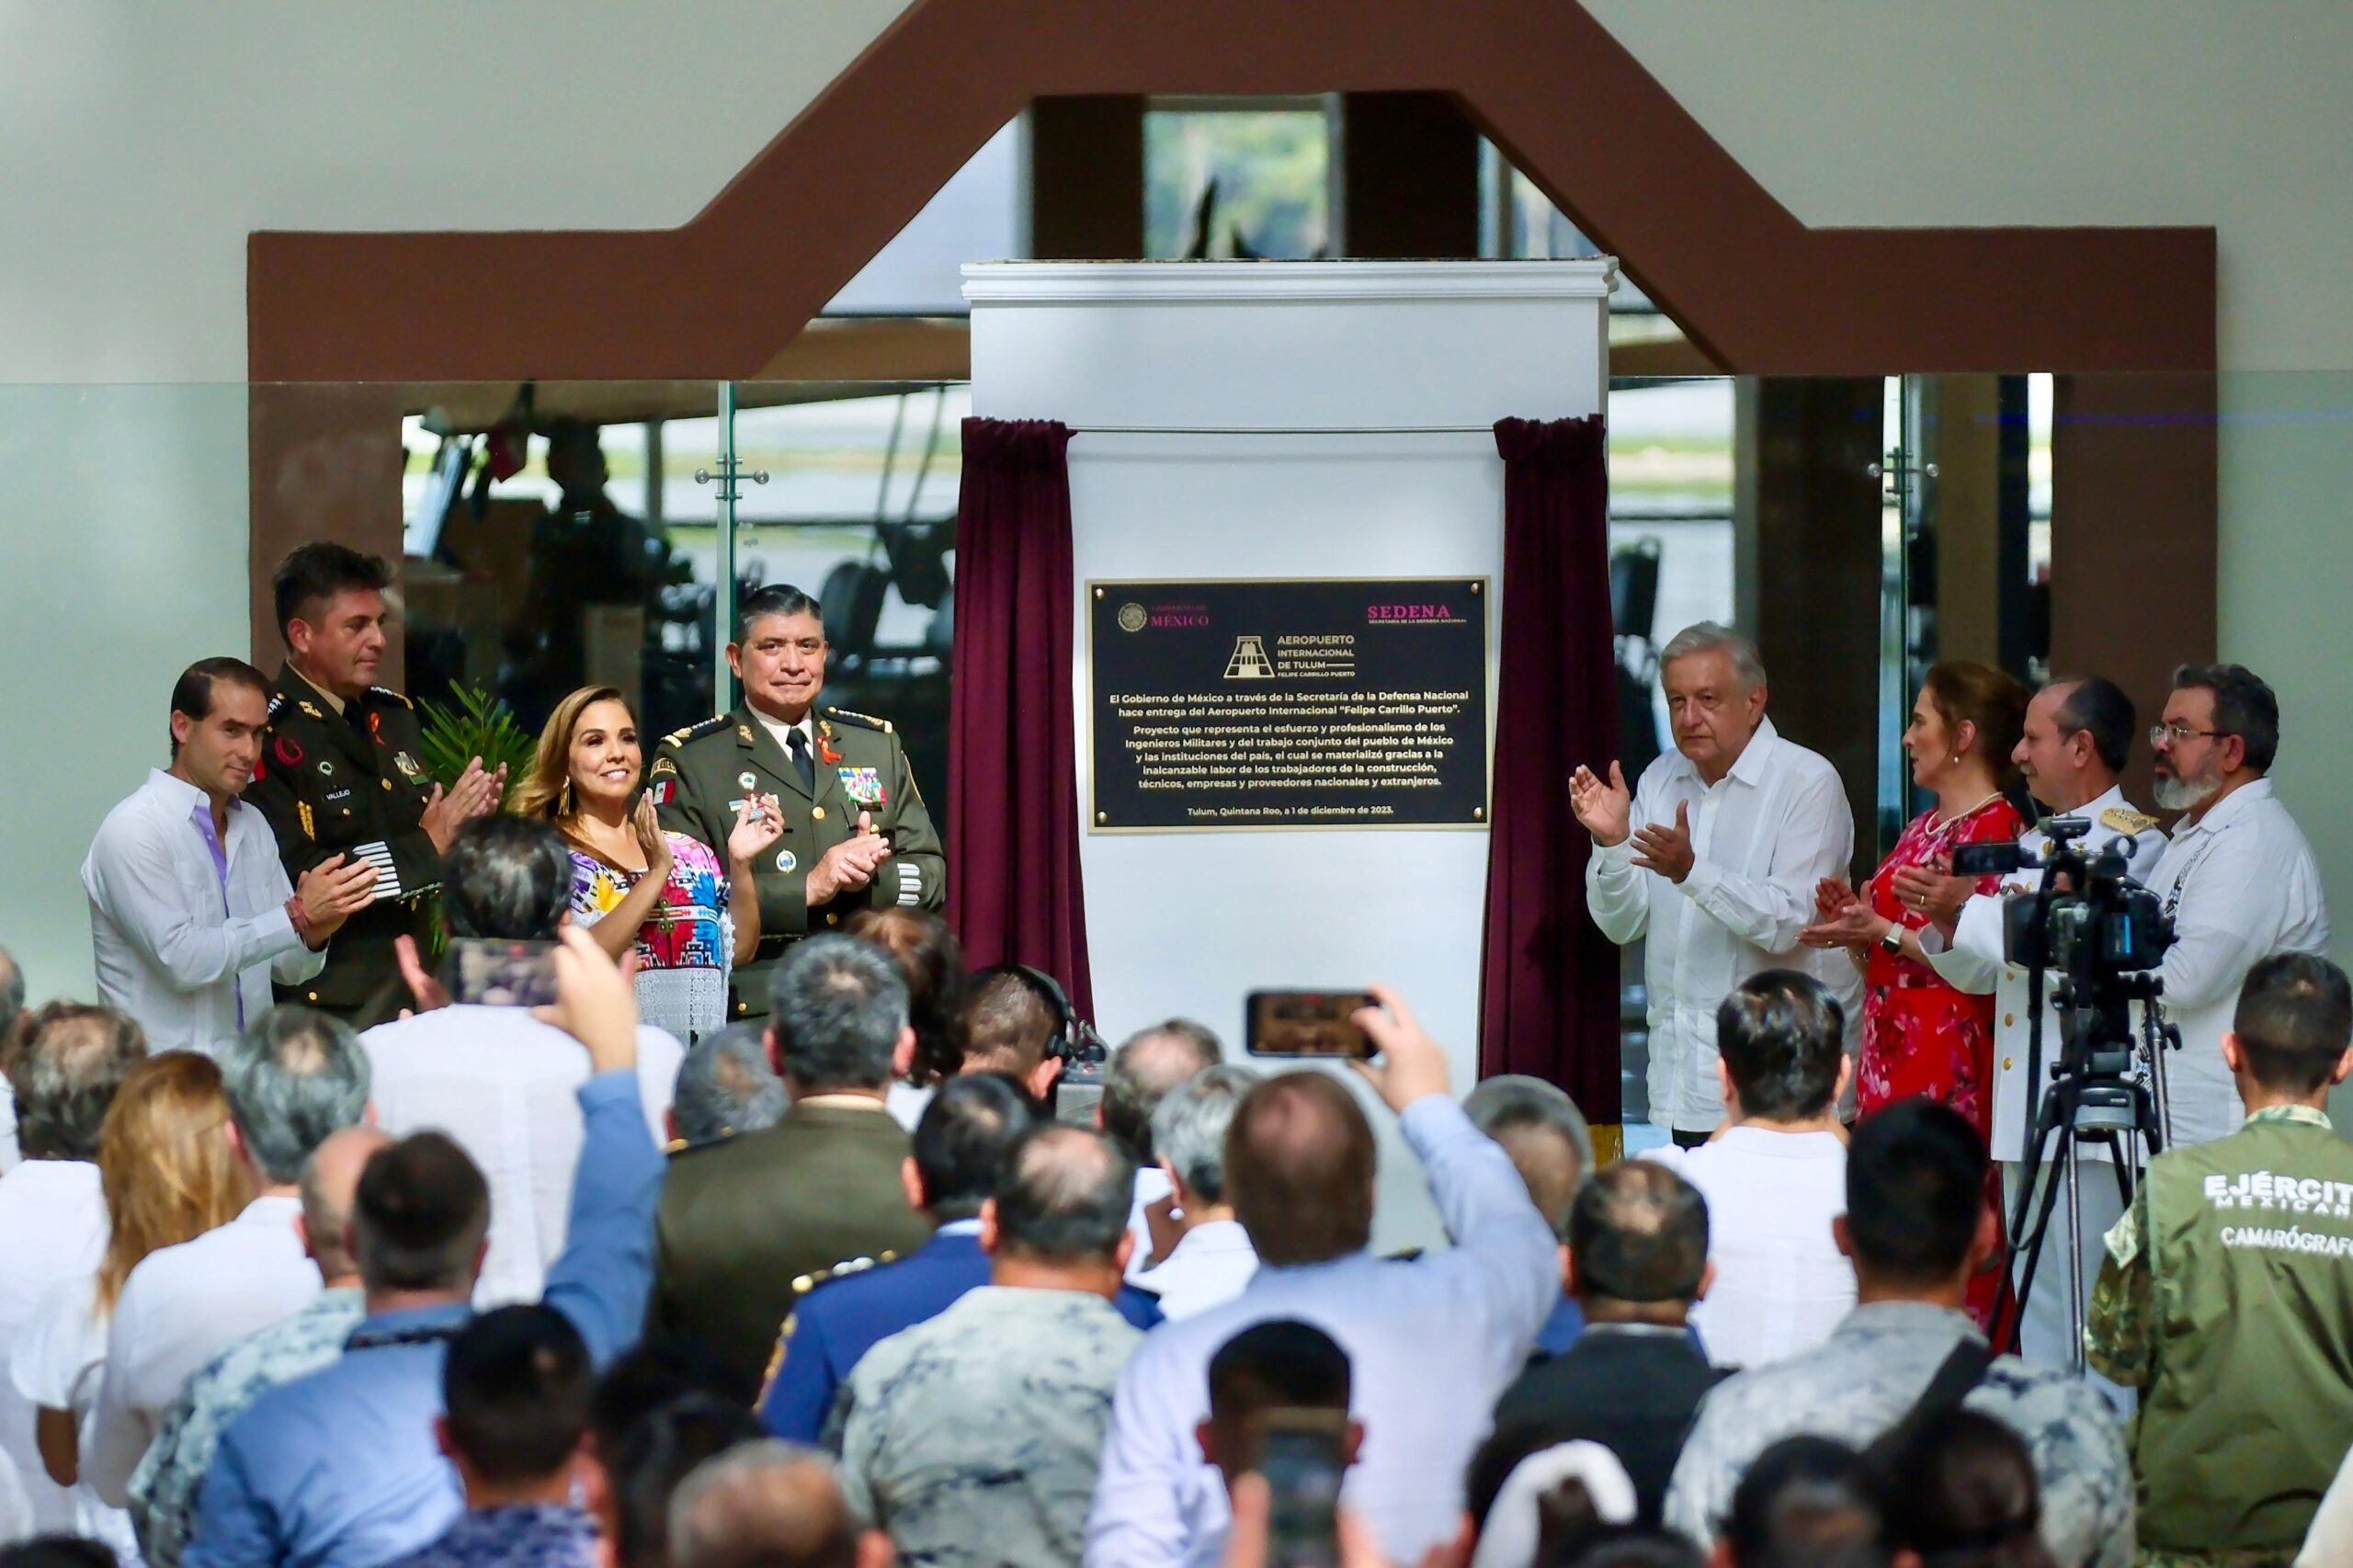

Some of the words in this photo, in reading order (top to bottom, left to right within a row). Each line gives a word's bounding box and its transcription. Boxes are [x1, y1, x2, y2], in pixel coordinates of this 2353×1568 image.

[1368, 605, 1450, 619] SEDENA
[1277, 635, 1355, 645] AEROPUERTO
[1277, 649, 1355, 657] INTERNACIONAL
[1278, 661, 1290, 669] DE
[1293, 661, 1325, 669] TULUM
[1110, 695, 1120, 704] El
[1121, 694, 1169, 704] Gobierno
[1172, 694, 1185, 703] de
[1188, 693, 1224, 702] México
[1235, 693, 1267, 702] través
[1269, 693, 1282, 701] de
[1285, 693, 1294, 701] la
[1297, 692, 1348, 701] Secretaría
[1351, 692, 1365, 701] de
[1367, 691, 1376, 701] la
[1379, 691, 1421, 701] Defensa
[1424, 690, 1469, 700] Nacional
[1119, 708, 1143, 717] hace
[1146, 709, 1187, 718] entrega
[1188, 707, 1205, 716] del
[1208, 708, 1267, 717] Aeropuerto
[1268, 706, 1337, 715] Internacional
[1339, 705, 1376, 716] “Felipe
[1378, 704, 1415, 715] Carrillo
[1417, 704, 1461, 714] Puerto”.
[1133, 726, 1179, 736] Proyecto
[1182, 727, 1201, 735] que
[1204, 725, 1260, 735] representa
[1262, 724, 1272, 733] el
[1274, 724, 1319, 733] esfuerzo
[1321, 725, 1327, 734] y
[1330, 722, 1413, 734] profesionalismo
[1415, 722, 1427, 733] de
[1430, 722, 1446, 733] los
[1126, 738, 1180, 750] Ingenieros
[1183, 738, 1227, 747] Militares
[1229, 740, 1235, 749] y
[1238, 738, 1254, 747] del
[1256, 737, 1293, 748] trabajo
[1295, 737, 1342, 748] conjunto
[1344, 736, 1360, 746] del
[1363, 736, 1399, 747] pueblo
[1401, 736, 1415, 746] de
[1417, 735, 1454, 745] México
[1136, 755, 1142, 763] y
[1144, 753, 1159, 762] las
[1162, 751, 1228, 761] instituciones
[1231, 751, 1246, 760] del
[1249, 751, 1273, 762] país,
[1275, 751, 1284, 760] el
[1287, 751, 1309, 760] cual
[1325, 749, 1383, 760] materializó
[1385, 749, 1423, 761] gracias
[1425, 751, 1432, 759] a
[1434, 749, 1443, 759] la
[1143, 766, 1208, 775] inalcanzable
[1211, 766, 1236, 774] labor
[1239, 765, 1252, 774] de
[1255, 765, 1269, 773] los
[1272, 764, 1337, 775] trabajadores
[1339, 764, 1353, 773] de
[1355, 764, 1364, 773] la
[1367, 763, 1437, 773] construcción,
[1138, 779, 1185, 790] técnicos,
[1187, 780, 1237, 790] empresas
[1239, 780, 1245, 790] y
[1248, 778, 1313, 789] proveedores
[1314, 777, 1370, 787] nacionales
[1371, 778, 1379, 788] y
[1381, 776, 1441, 788] extranjeros.
[325, 790, 351, 801] VALLEJO
[1188, 808, 1218, 816] Tulum,
[1220, 807, 1261, 816] Quintana
[1263, 807, 1282, 815] Roo,
[1297, 807, 1309, 815] de
[1311, 806, 1356, 815] diciembre
[1358, 806, 1370, 814] de
[1370, 806, 1394, 815] 2023.
